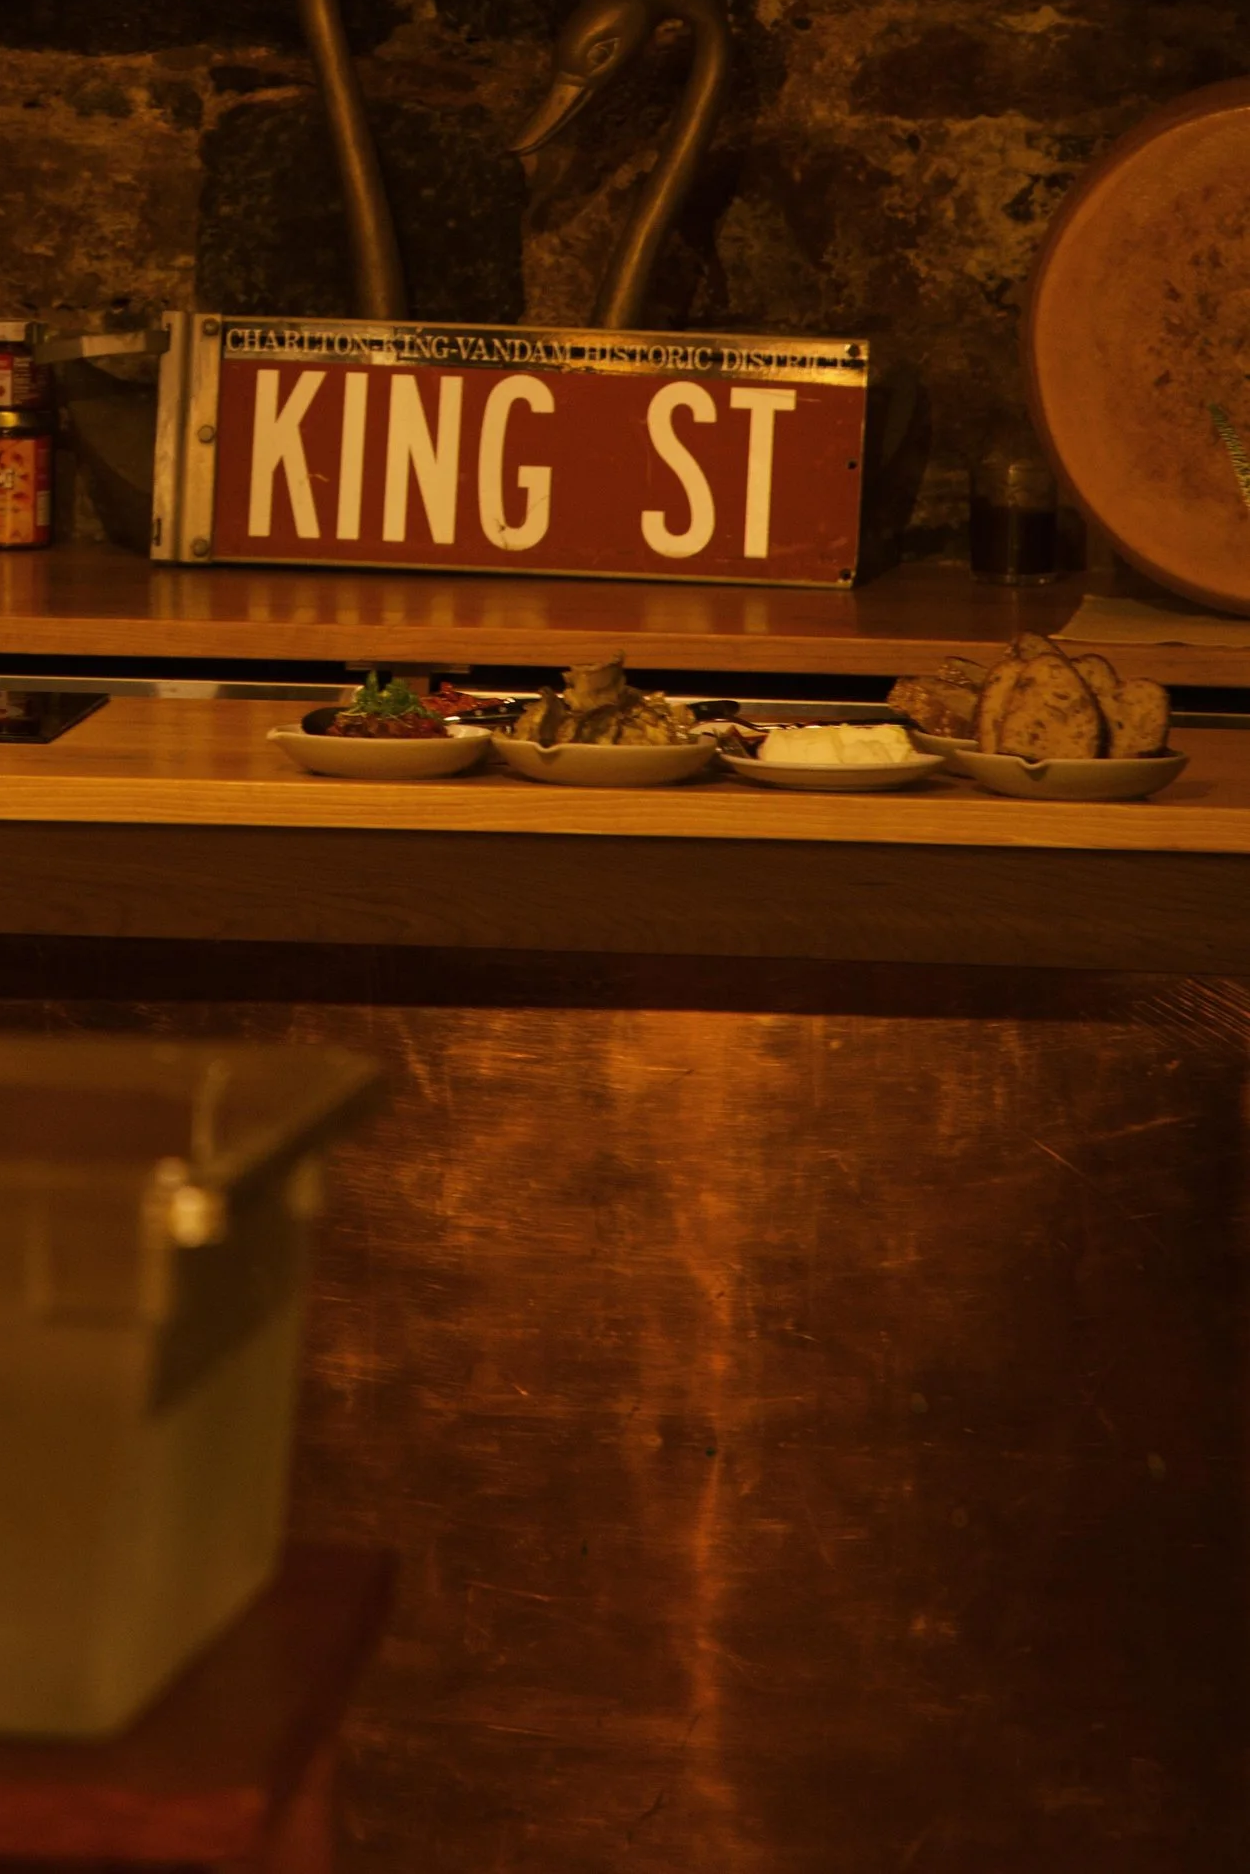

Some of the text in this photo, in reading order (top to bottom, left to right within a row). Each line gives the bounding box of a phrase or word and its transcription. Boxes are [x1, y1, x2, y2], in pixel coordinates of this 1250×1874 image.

[584, 342, 714, 370] HISTORIC
[247, 369, 798, 560] KING ST
